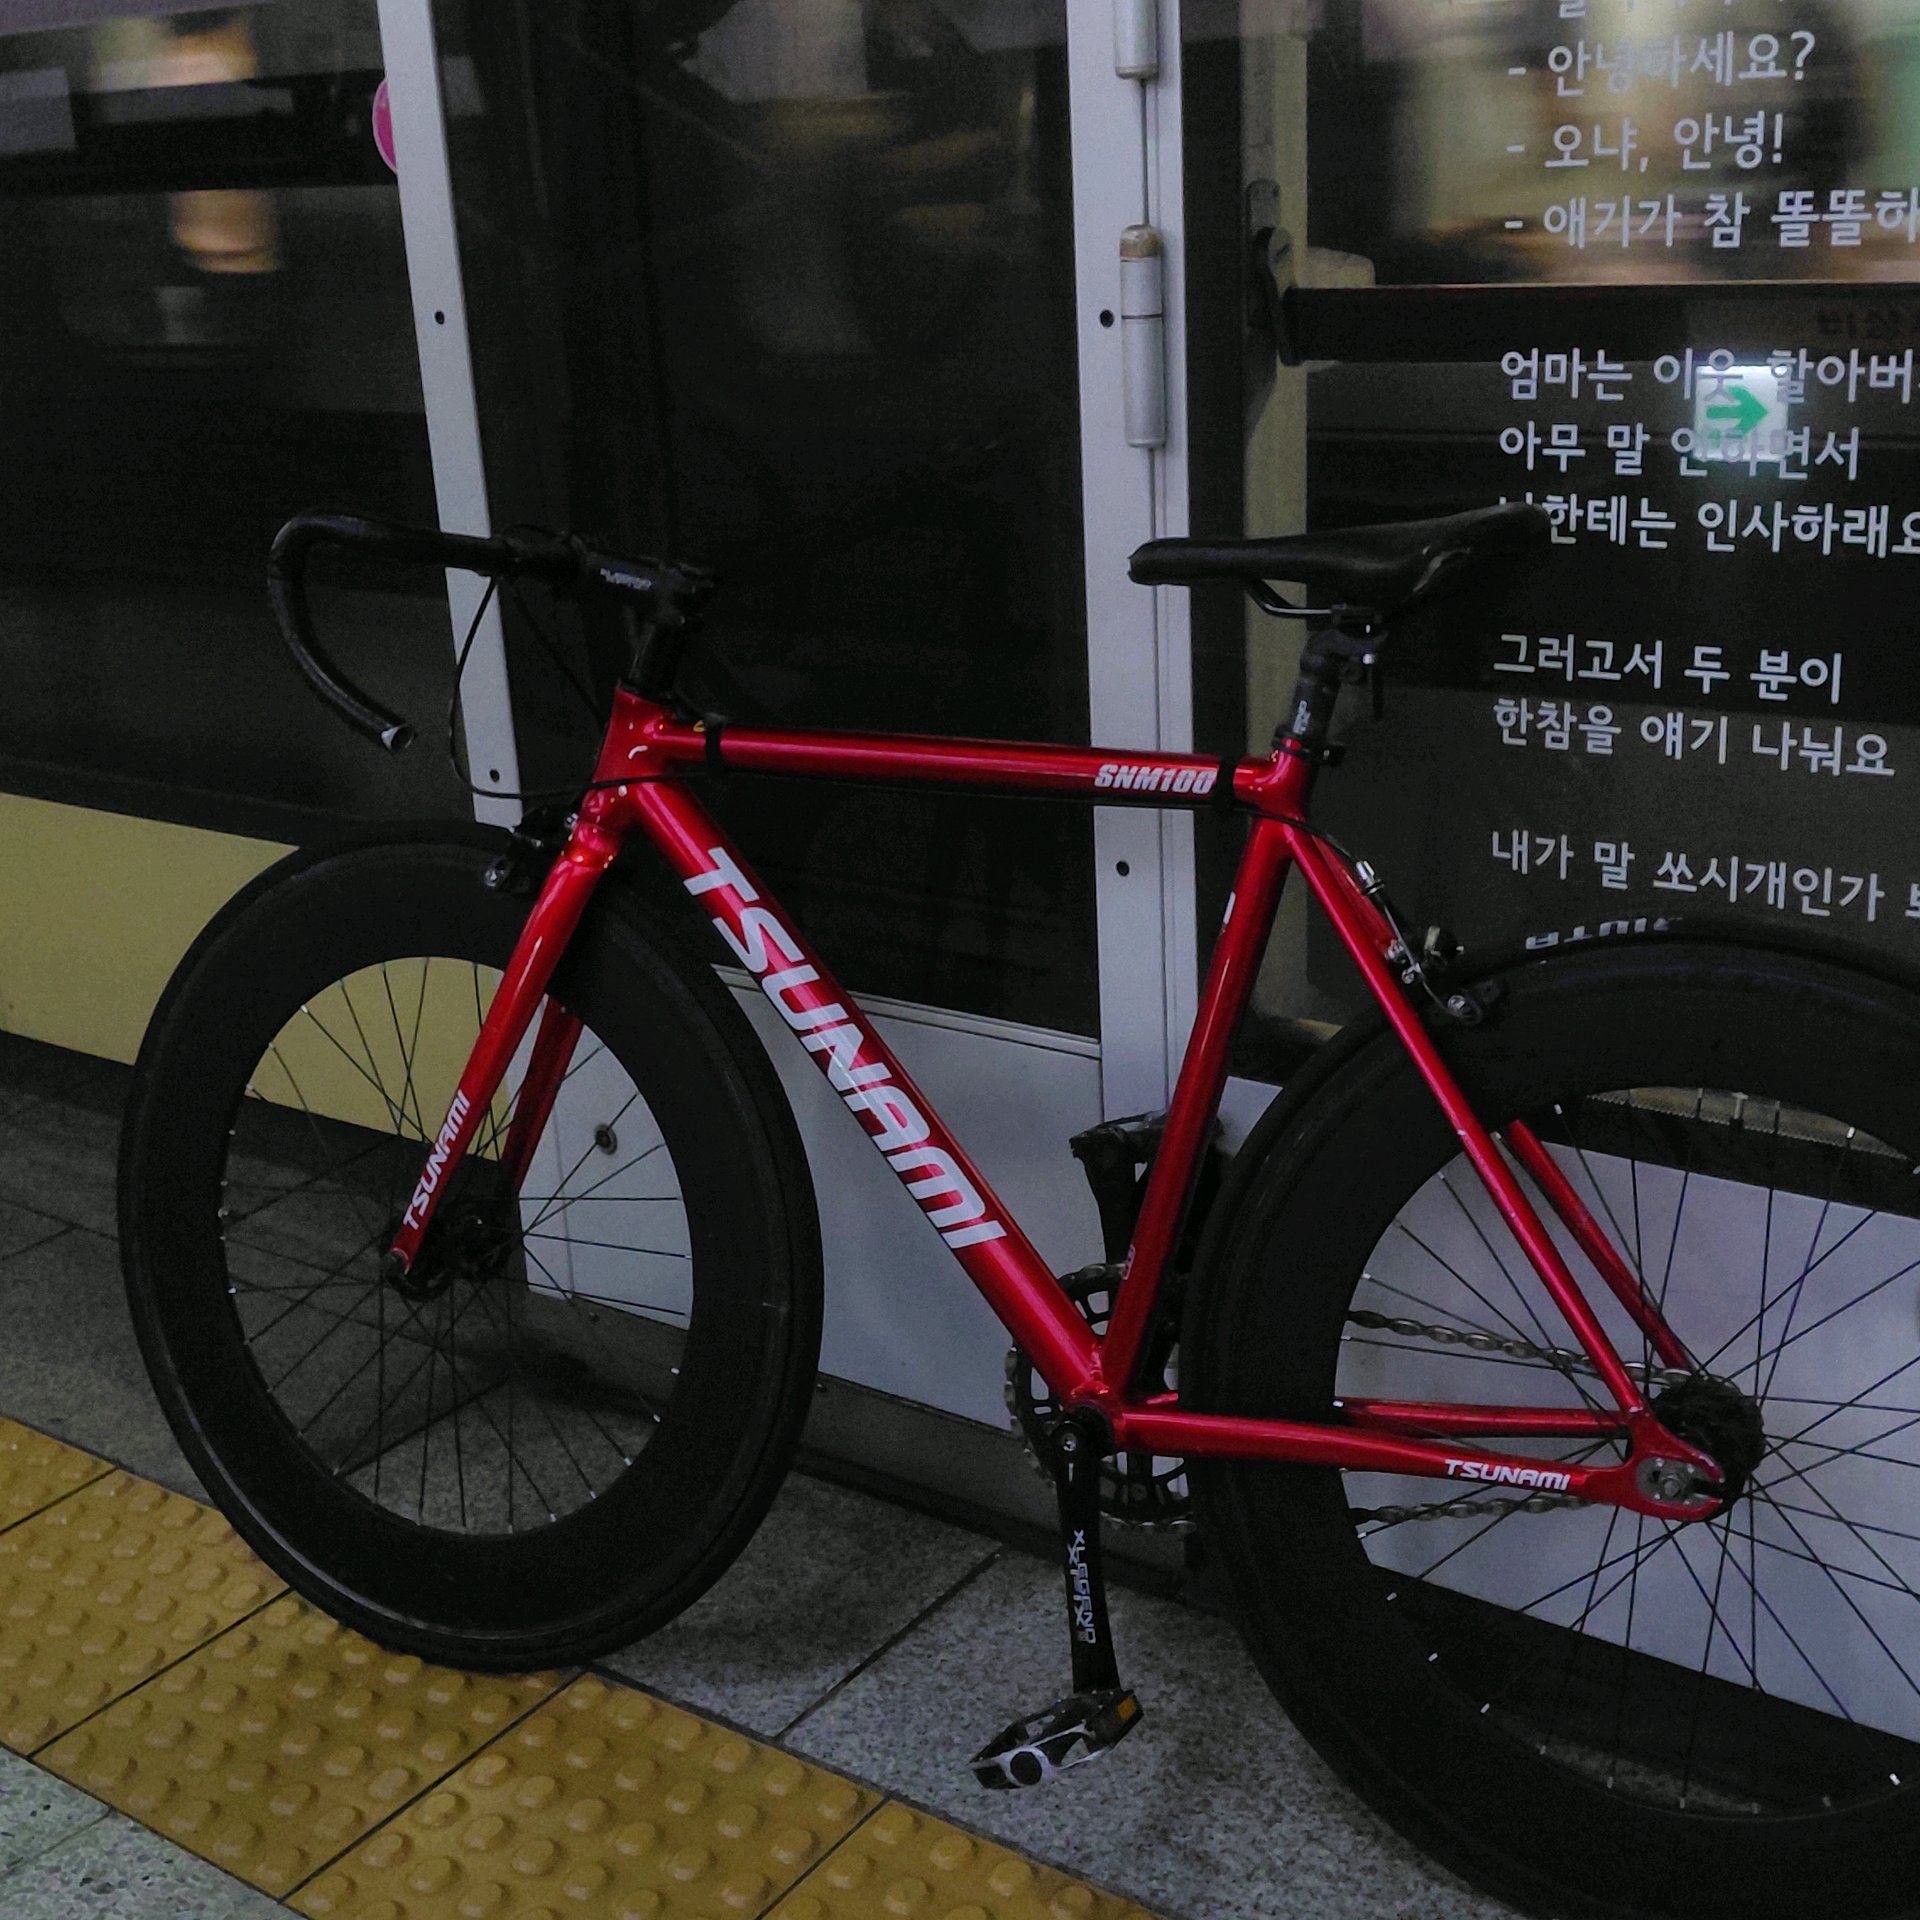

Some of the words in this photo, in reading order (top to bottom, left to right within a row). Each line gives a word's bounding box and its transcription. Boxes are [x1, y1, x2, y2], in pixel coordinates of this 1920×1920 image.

[1547, 30, 1816, 97] 안녕하세요?
[1544, 118, 1649, 173] 오냐,
[1674, 110, 1785, 170] 안녕!
[1543, 193, 1683, 249] 애기가
[1703, 190, 1751, 248] 참
[1500, 347, 1634, 401] 엄마는
[1653, 347, 1744, 401] 이웃
[1766, 348, 1920, 404] 할아버
[1499, 420, 1587, 473] 아무
[1607, 422, 1651, 476] 말
[1500, 492, 1677, 549] 한테는
[1493, 633, 1664, 690] 그러고서
[1683, 645, 1731, 695] 두
[1749, 649, 1843, 705] 분이
[1492, 697, 1622, 756] 한참을
[1640, 711, 1729, 765] 얘기
[1752, 721, 1896, 777] 나눠요
[1094, 764, 1218, 794] SNM100
[1491, 829, 1575, 881] 내가
[1593, 841, 1636, 890] 말
[1652, 851, 1886, 922] 쏘시개인가
[682, 846, 1008, 1249] TSUNAMI
[402, 1089, 471, 1231] TSUNAMI
[1445, 1458, 1571, 1491] TSUNAMI
